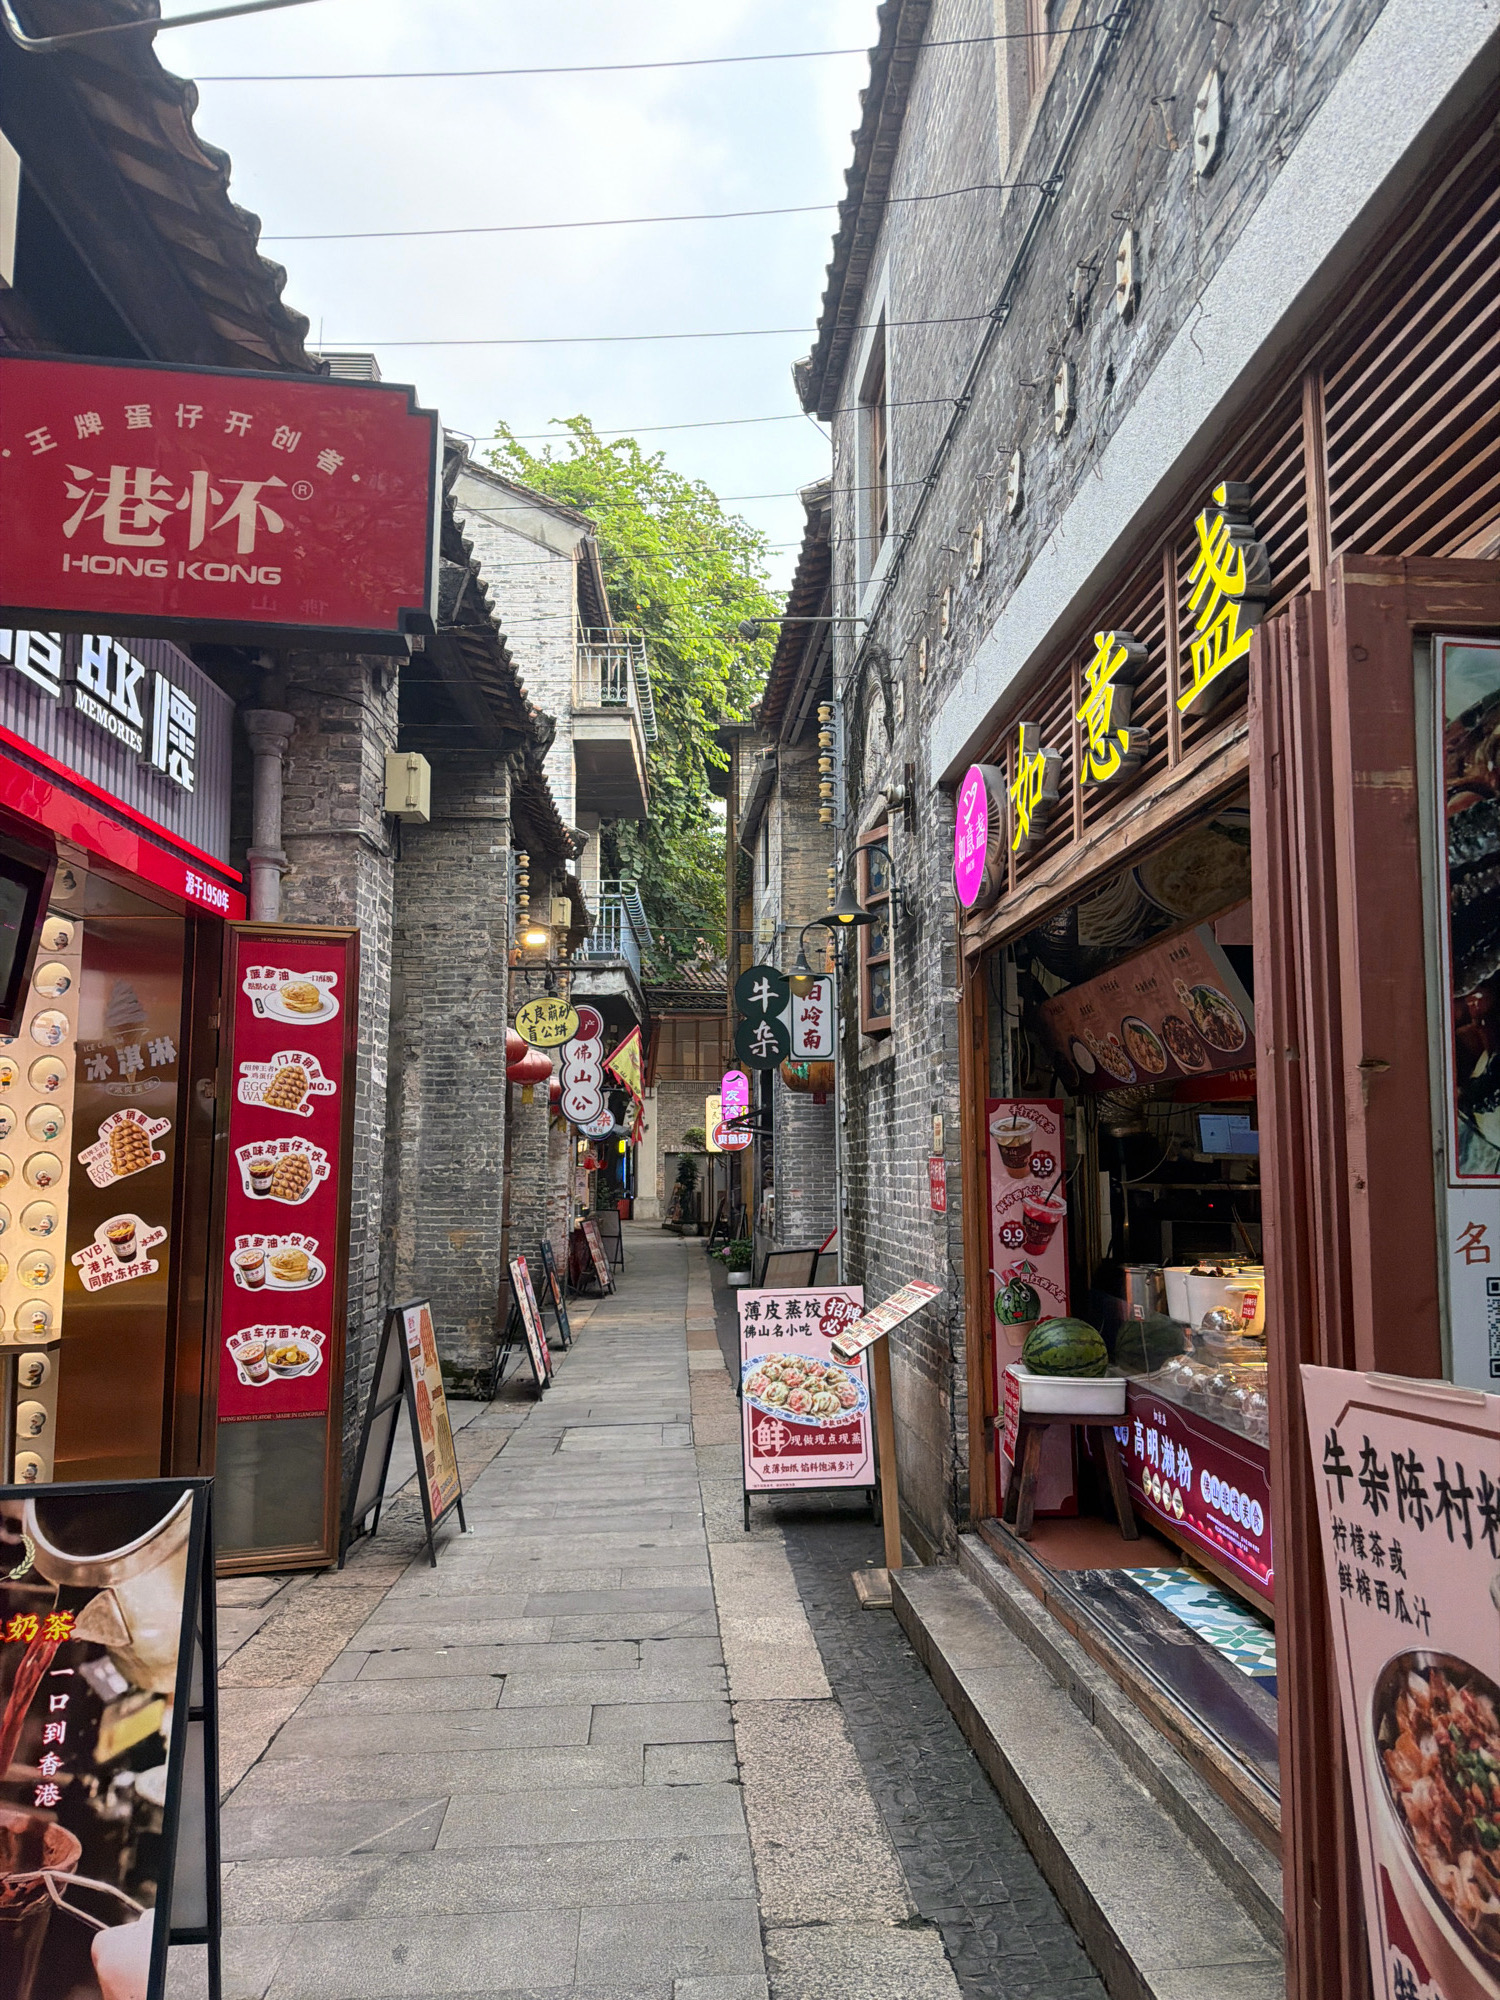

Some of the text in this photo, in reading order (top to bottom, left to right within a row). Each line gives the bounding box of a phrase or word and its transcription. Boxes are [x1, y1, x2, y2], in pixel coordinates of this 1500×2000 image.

[62, 553, 281, 585] HONG KONG
[1010, 481, 1254, 851] 如意盏
[76, 633, 145, 729] HK
[75, 688, 143, 753] MEMORIES
[185, 869, 229, 912] 源于1950年
[521, 1003, 572, 1024] 大良崩砂
[748, 976, 779, 1057] 牛杂
[84, 1036, 177, 1081] 冰淇淋
[277, 1053, 321, 1079] 门店销量
[242, 1091, 266, 1101] WA
[243, 1081, 268, 1092] EGG
[308, 1082, 331, 1091] NO.1
[101, 1110, 148, 1134] 门店销量
[148, 1118, 169, 1136] NO.1
[89, 1159, 113, 1179] EGG
[1032, 1158, 1053, 1171] 9.9
[94, 1170, 117, 1186] WA
[1002, 1228, 1024, 1242] 9.9
[1454, 1220, 1490, 1266] 名
[77, 1244, 103, 1263] TVB
[88, 1255, 115, 1275] 港片
[88, 1260, 153, 1290] 同款冻柠茶
[744, 1299, 823, 1321] 薄皮蒸饺
[827, 1298, 862, 1323] 招牌
[743, 1322, 813, 1339] 佛山名小吃
[757, 1420, 785, 1451] 鲜
[790, 1432, 863, 1447] 现做现点现蒸
[1133, 1415, 1193, 1492] 高明濑粉
[763, 1461, 855, 1475] 皮薄如纸 馅料饱满多汁
[1332, 1515, 1407, 1580] 柠檬茶或
[1338, 1560, 1431, 1637] 鲜榨西瓜汁
[0, 1611, 75, 1641] 奶茶
[34, 1667, 74, 1807] 一口到香港
